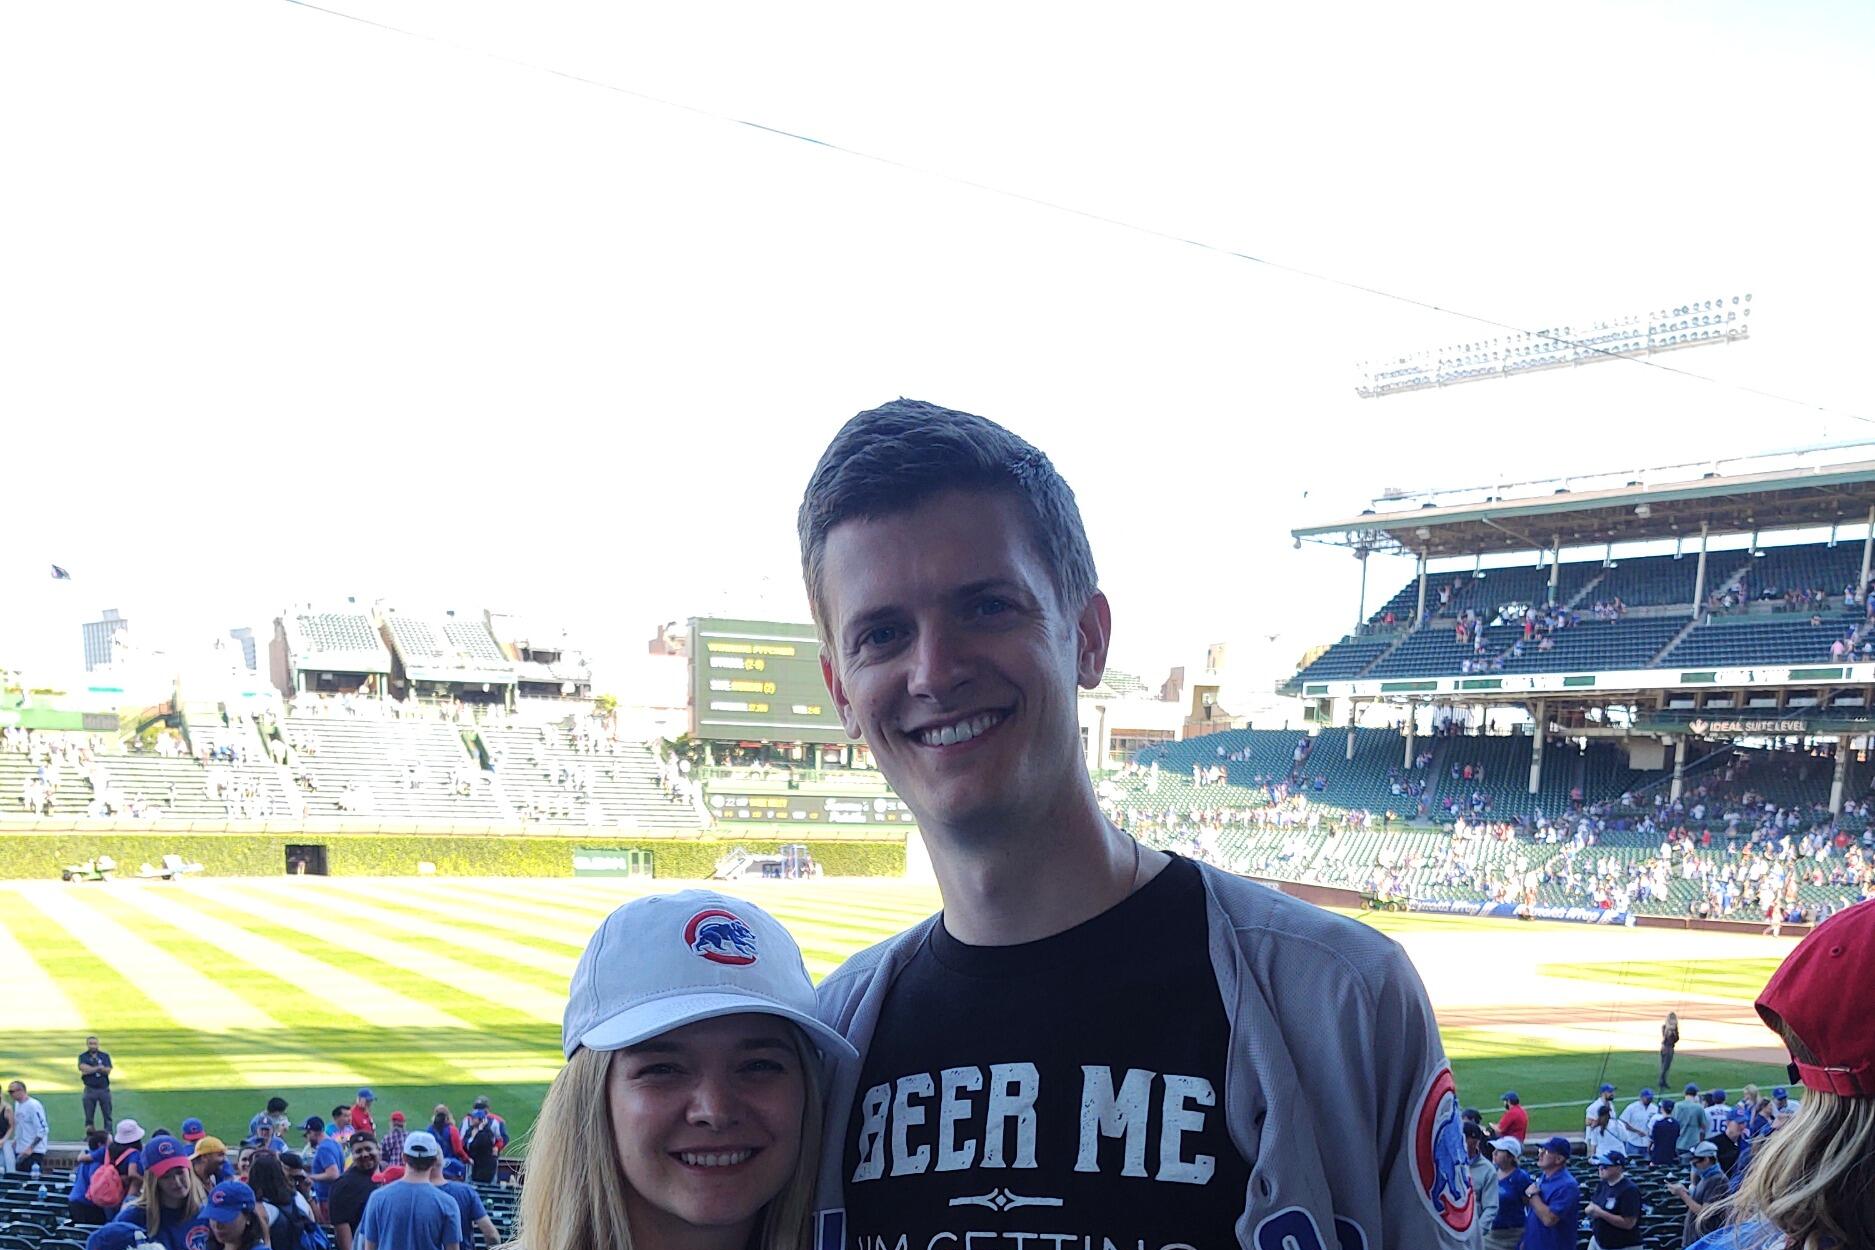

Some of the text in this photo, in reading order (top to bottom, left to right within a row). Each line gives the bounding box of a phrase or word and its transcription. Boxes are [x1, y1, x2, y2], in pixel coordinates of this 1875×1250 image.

[1709, 720, 1806, 732] IDEAL SUITE LEVEL
[851, 1062, 1216, 1185] BEER ME
